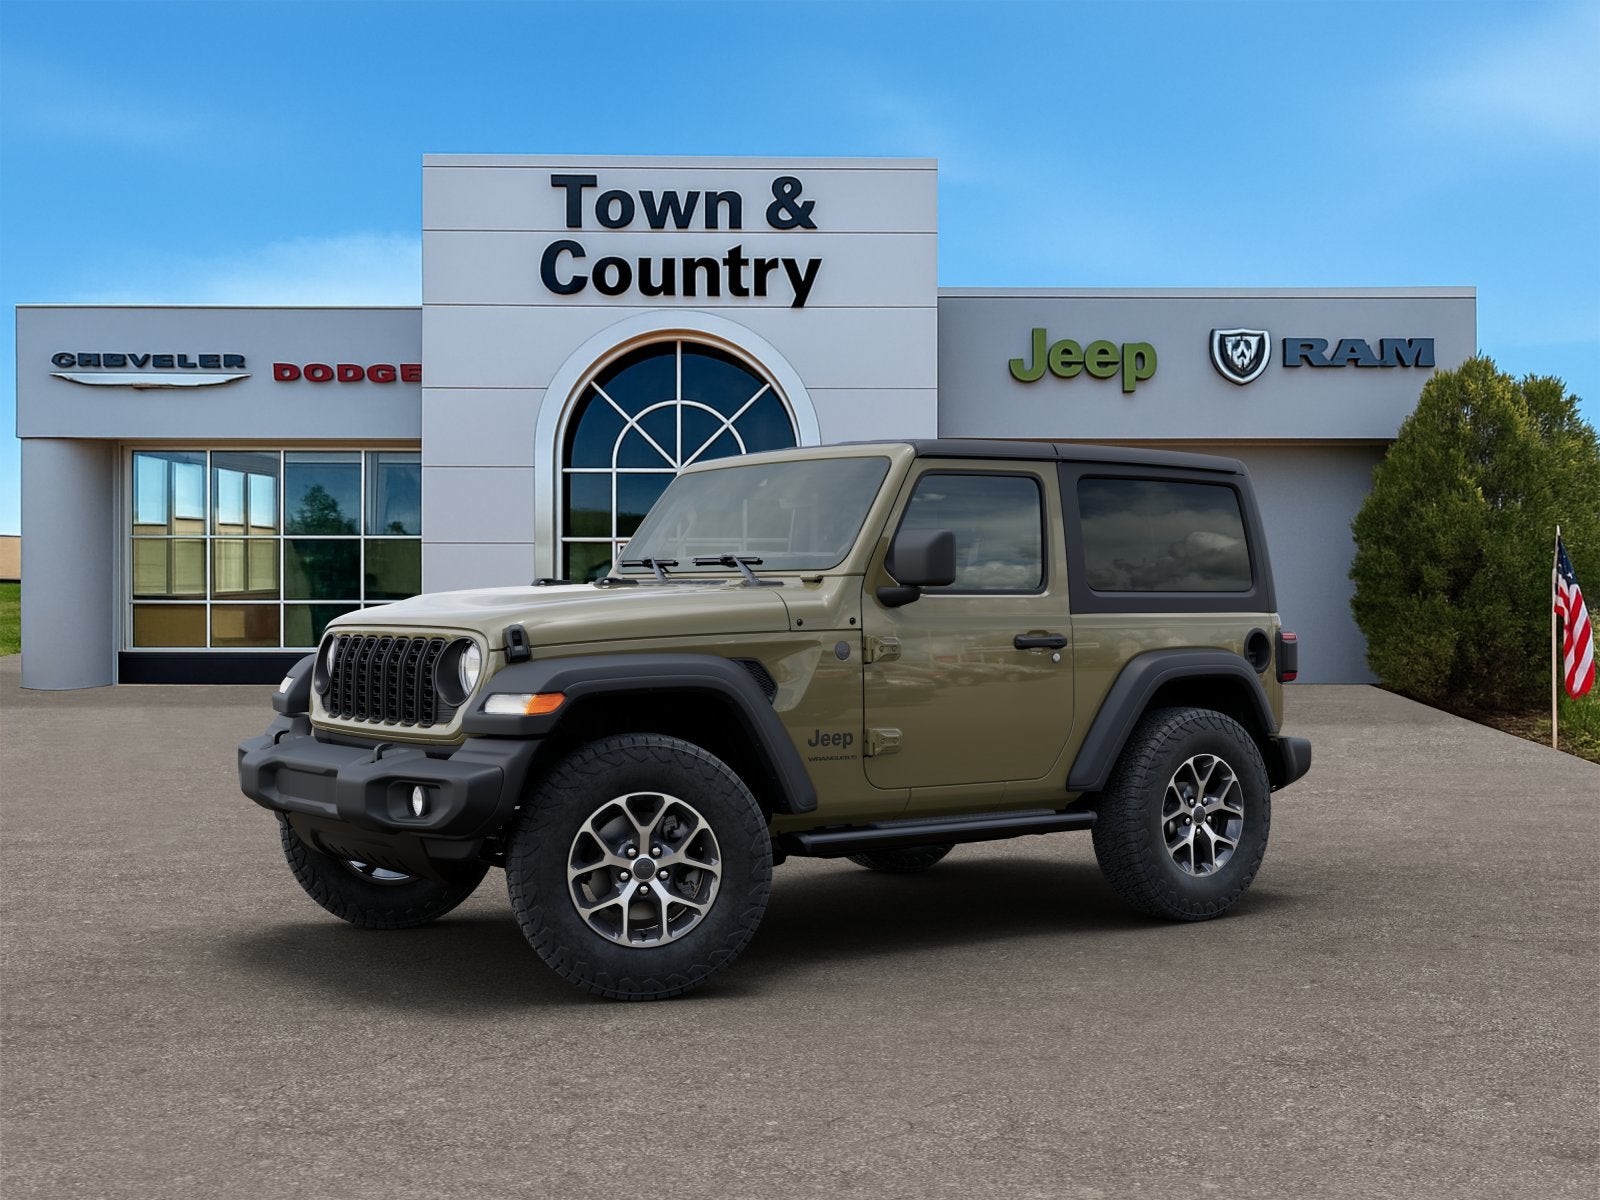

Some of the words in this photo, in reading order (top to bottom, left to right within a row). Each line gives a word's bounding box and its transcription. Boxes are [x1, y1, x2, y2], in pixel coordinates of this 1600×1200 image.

[551, 174, 742, 230] Town
[765, 175, 818, 230] &
[540, 239, 823, 308] Country
[273, 363, 422, 383] DODGE
[1009, 327, 1157, 393] Jeep
[1282, 337, 1435, 367] RAM
[807, 729, 854, 749] Jeep
